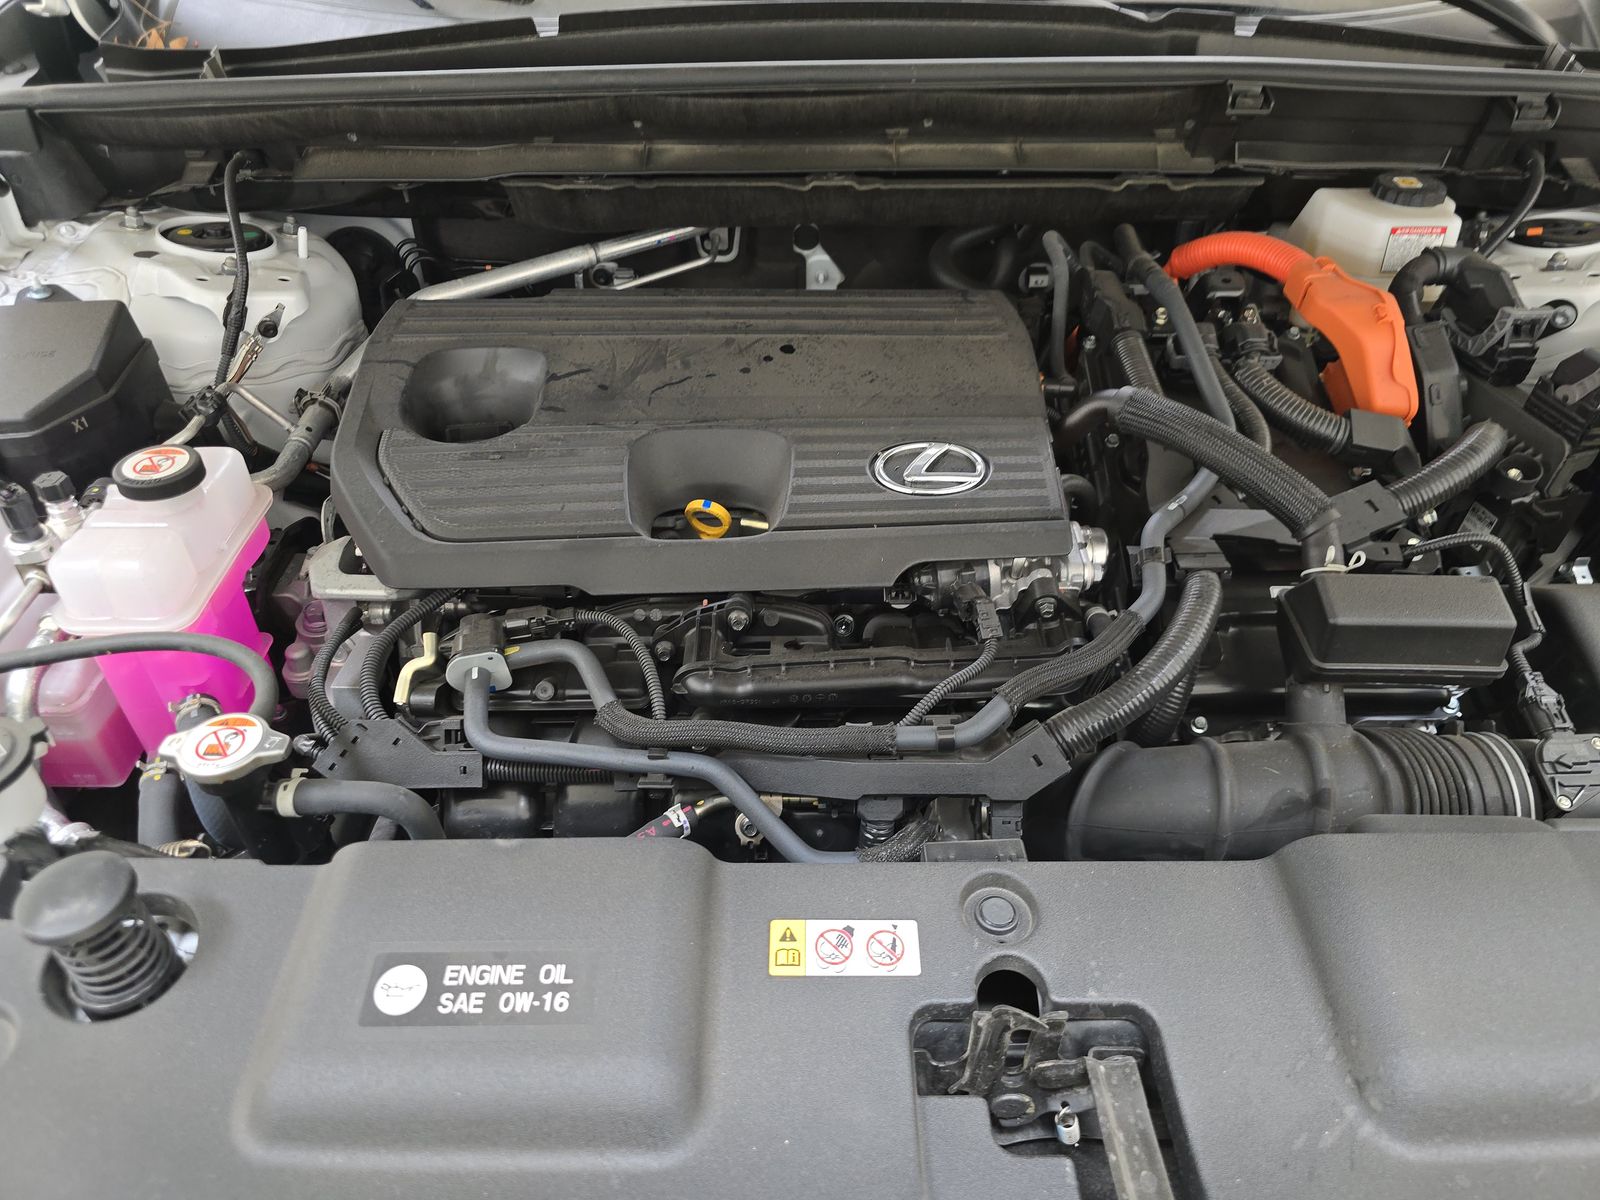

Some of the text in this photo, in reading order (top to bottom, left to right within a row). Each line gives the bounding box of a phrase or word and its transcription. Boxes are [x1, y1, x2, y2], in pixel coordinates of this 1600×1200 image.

[71, 416, 88, 433] X1
[443, 963, 574, 986] ENGINE OIL
[437, 991, 570, 1014] SAE 0W-16
